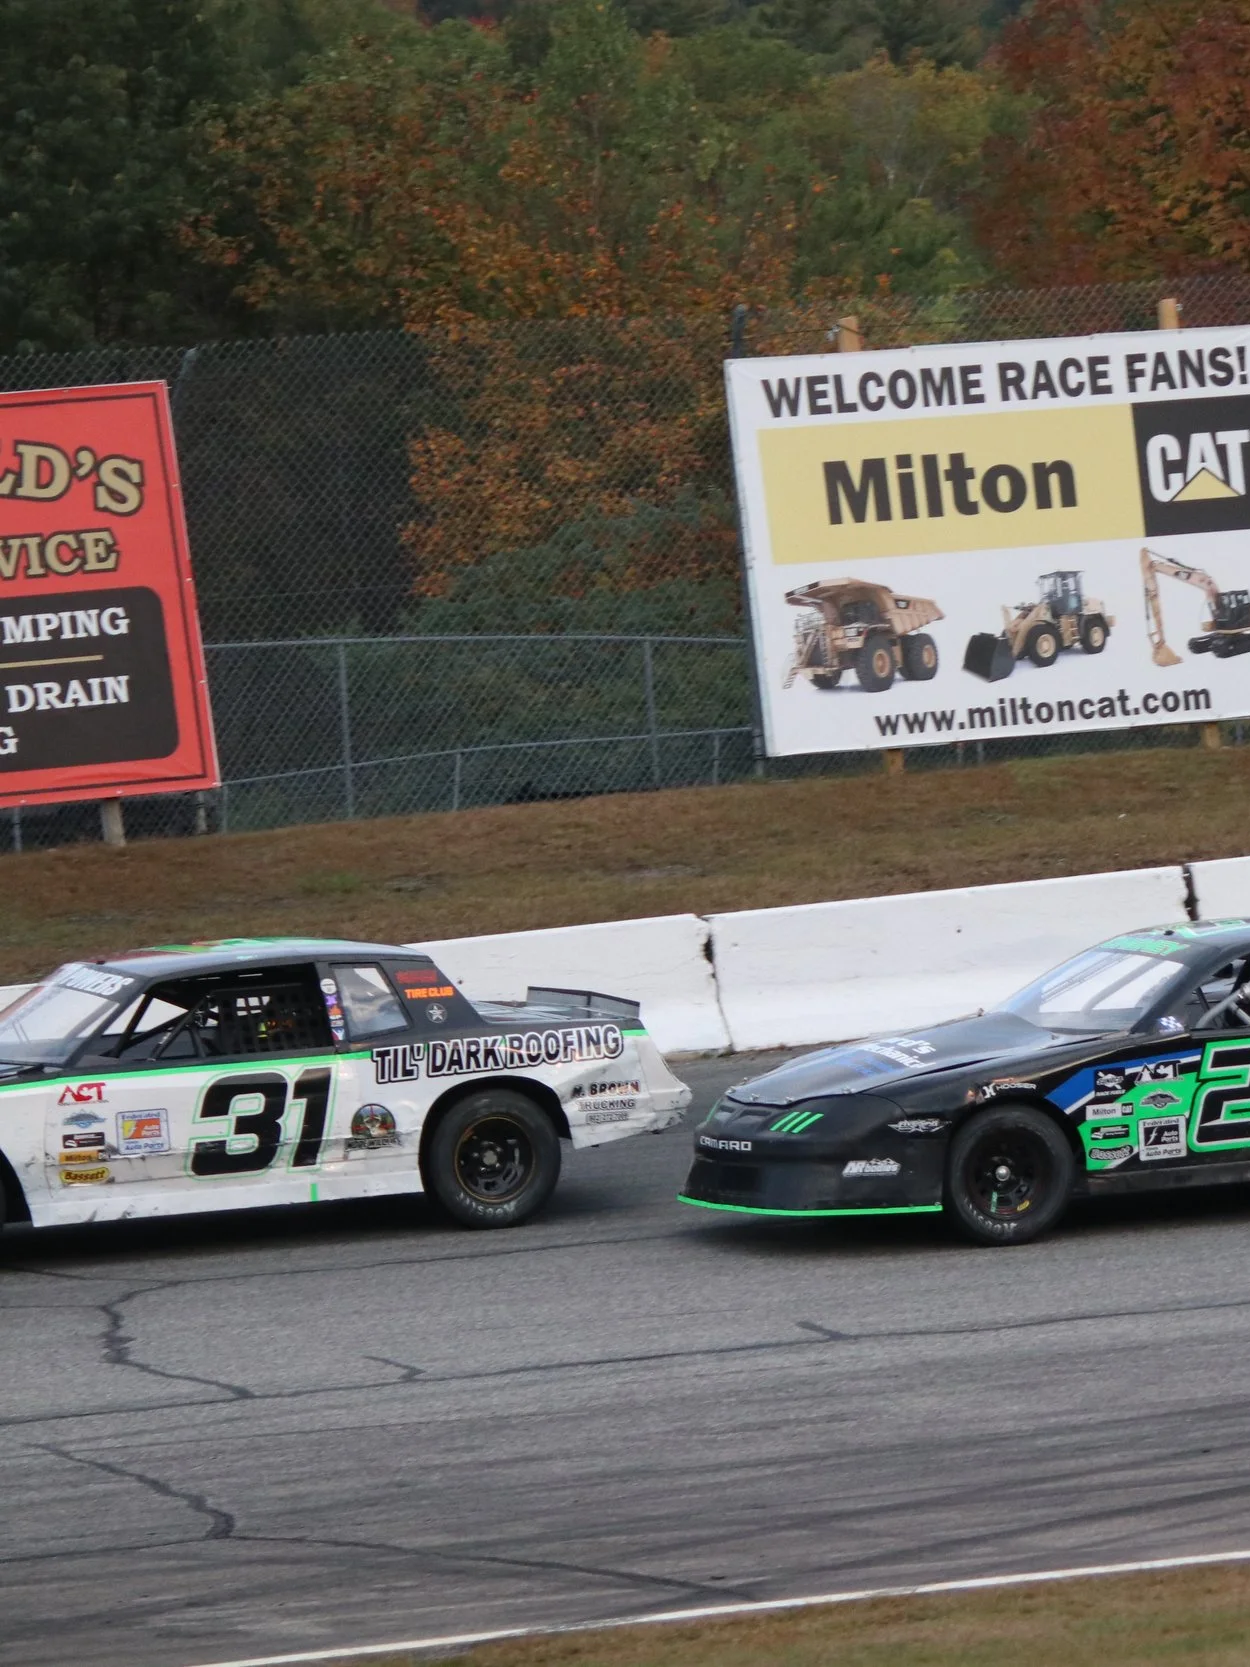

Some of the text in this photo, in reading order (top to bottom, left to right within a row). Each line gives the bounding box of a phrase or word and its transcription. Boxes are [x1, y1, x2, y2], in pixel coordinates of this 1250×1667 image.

[761, 346, 1249, 418] WELCOME RACE FANS!
[1146, 429, 1250, 503] CAT
[822, 452, 1078, 525] Milton
[1, 607, 129, 644] MPING
[6, 675, 129, 714] DRAIN
[874, 688, 1212, 736] www.miltoncat.com
[404, 986, 454, 999] TIRE CLUB
[372, 1025, 624, 1084] TIL' DARK ROOFING
[57, 1082, 106, 1105] ACT
[590, 1079, 640, 1096] BROWN
[996, 1082, 1036, 1090] HOOSIER
[578, 1099, 636, 1111] TRUCKING
[1092, 1107, 1116, 1115] Milton
[189, 1065, 334, 1177] 31
[700, 1136, 752, 1151] CAMARO
[1163, 1129, 1178, 1137] Auto
[64, 1169, 106, 1180] Bassett
